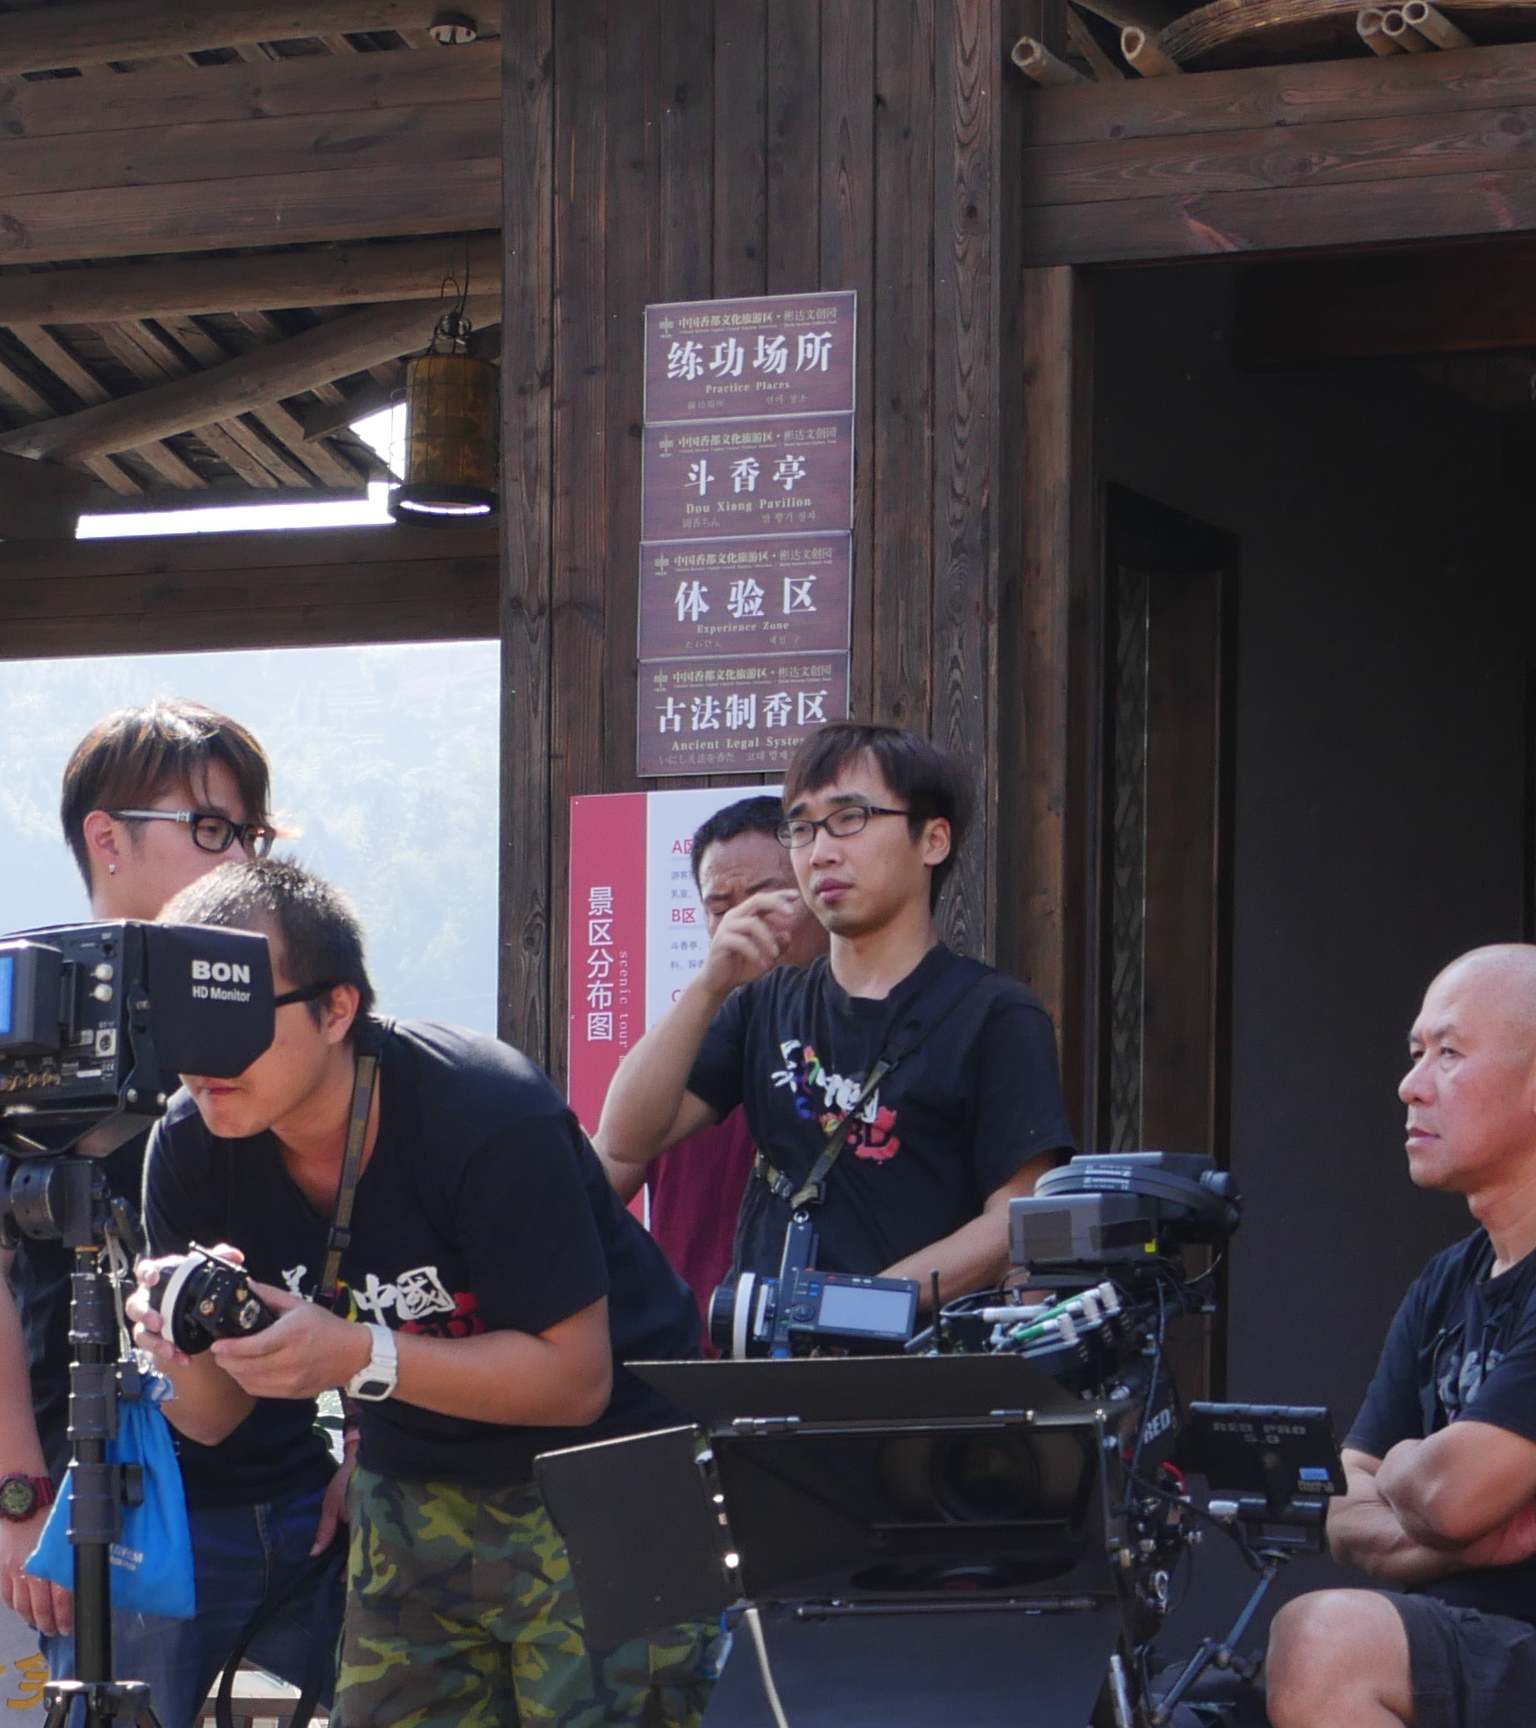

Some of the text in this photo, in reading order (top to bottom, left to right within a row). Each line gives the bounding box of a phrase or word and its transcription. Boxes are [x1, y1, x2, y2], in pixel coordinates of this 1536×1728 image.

[667, 331, 833, 381] 练功场所
[705, 380, 790, 394] Practice Places
[684, 454, 807, 496] 斗香亭
[686, 497, 812, 514] Dou Xiang Pavilion
[675, 574, 817, 622] 体验区
[696, 621, 789, 635] Experience Zone
[655, 690, 828, 733] 古法制香区
[672, 740, 719, 751] Ancient
[726, 737, 759, 751] Legal
[671, 908, 696, 923] B区
[192, 960, 251, 984] BON
[587, 886, 614, 1042] 景区分布图
[619, 950, 629, 1004] scenic
[192, 985, 251, 1002] HD Monitor
[619, 1013, 629, 1049] tour
[1143, 1408, 1171, 1445] RED
